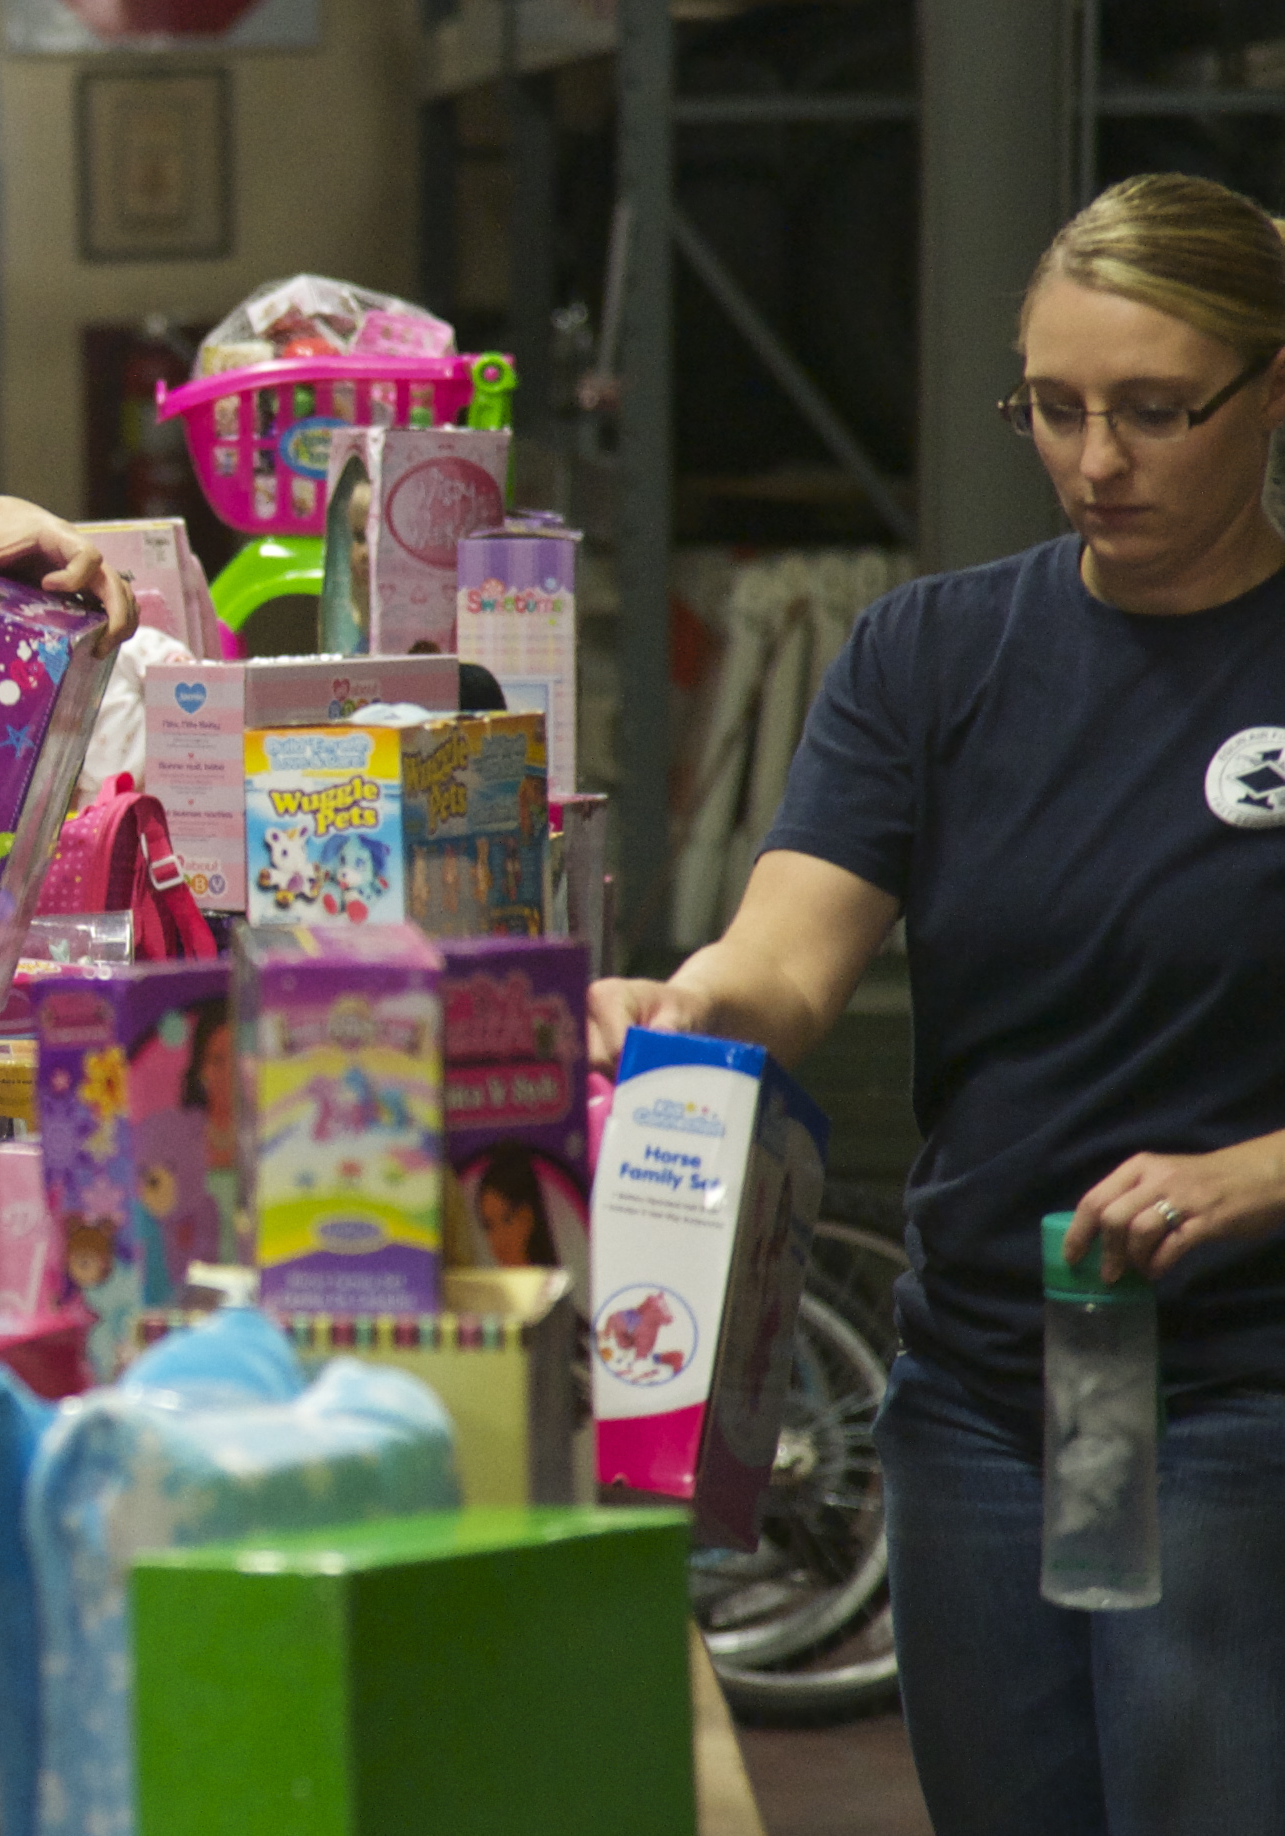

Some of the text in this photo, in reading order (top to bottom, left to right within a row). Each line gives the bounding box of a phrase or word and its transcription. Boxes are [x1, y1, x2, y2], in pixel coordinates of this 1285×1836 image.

[269, 776, 379, 817] Wuggle
[314, 805, 378, 837] Pets
[643, 1144, 702, 1170] Horse
[619, 1161, 683, 1192] Family
